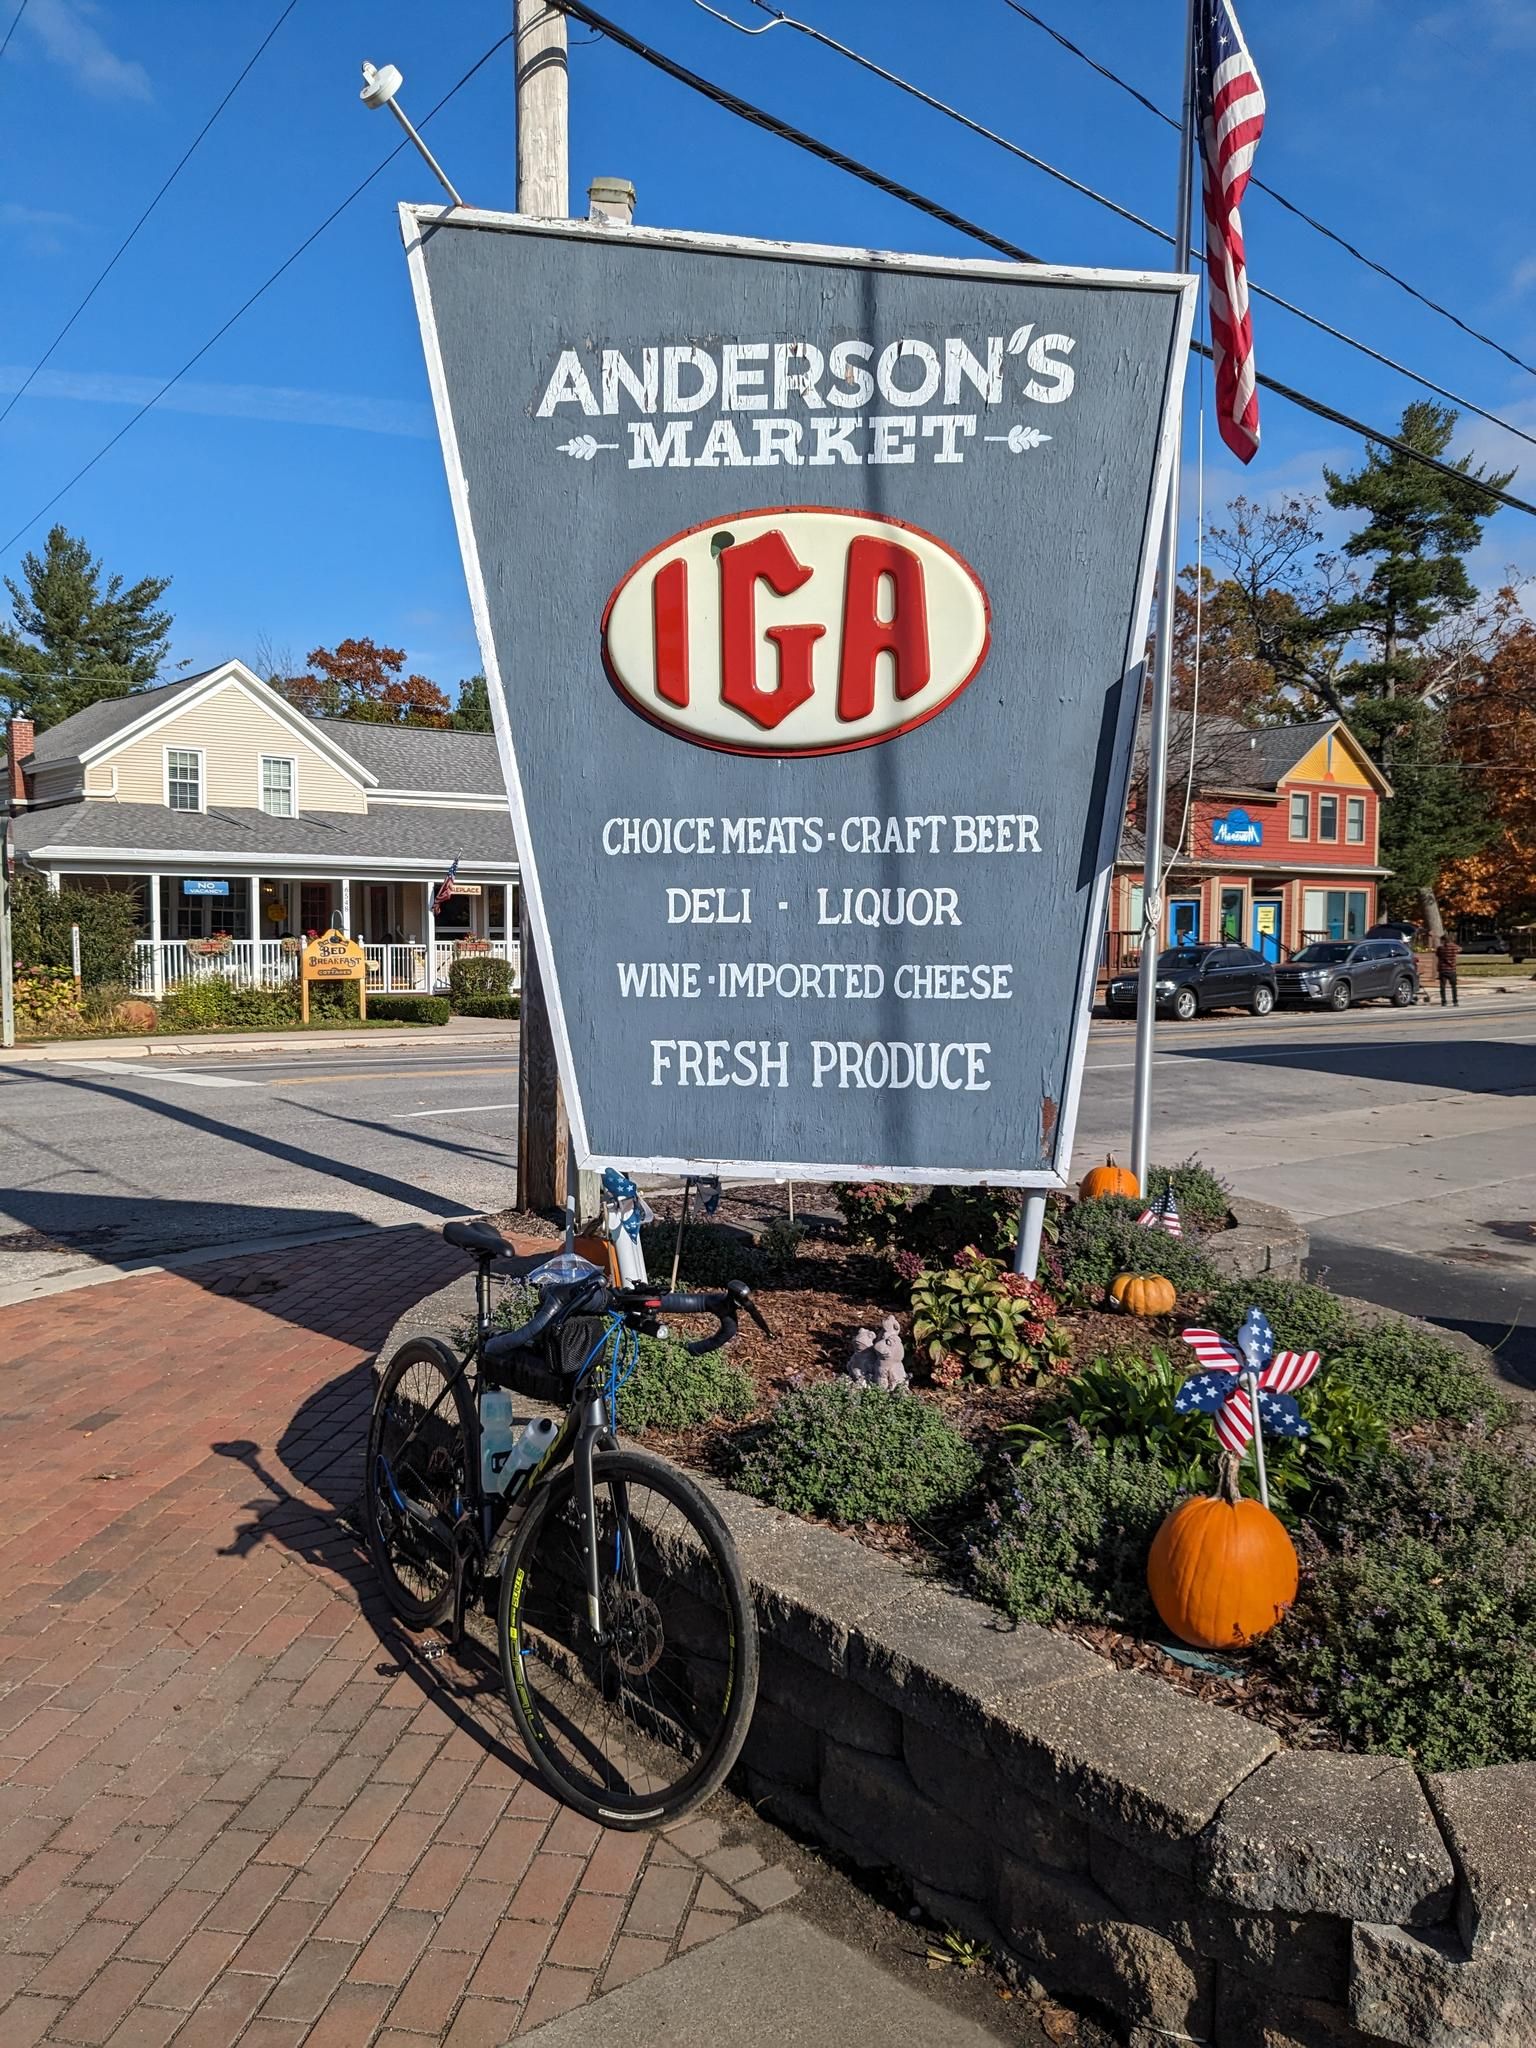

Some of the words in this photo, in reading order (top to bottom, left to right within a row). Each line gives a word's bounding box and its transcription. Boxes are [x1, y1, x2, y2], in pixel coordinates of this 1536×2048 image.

[535, 323, 1076, 417] ANDERSON'S
[627, 414, 977, 469] MARKET
[653, 529, 931, 730] IGA
[603, 817, 715, 855] CHOICE
[721, 817, 823, 853] MEATS
[841, 816, 946, 853] CRAFT
[952, 815, 1042, 853] BEER
[666, 888, 751, 923] DELI
[818, 888, 962, 927] LIQUOR
[309, 956, 361, 967] BREAKFAST
[320, 945, 346, 957] BED
[617, 963, 701, 997] WINE
[719, 963, 884, 998] IMPORTED
[894, 964, 1013, 999] CHEESE
[651, 1040, 788, 1087] FRESH
[811, 1041, 991, 1090] PRODUCE
